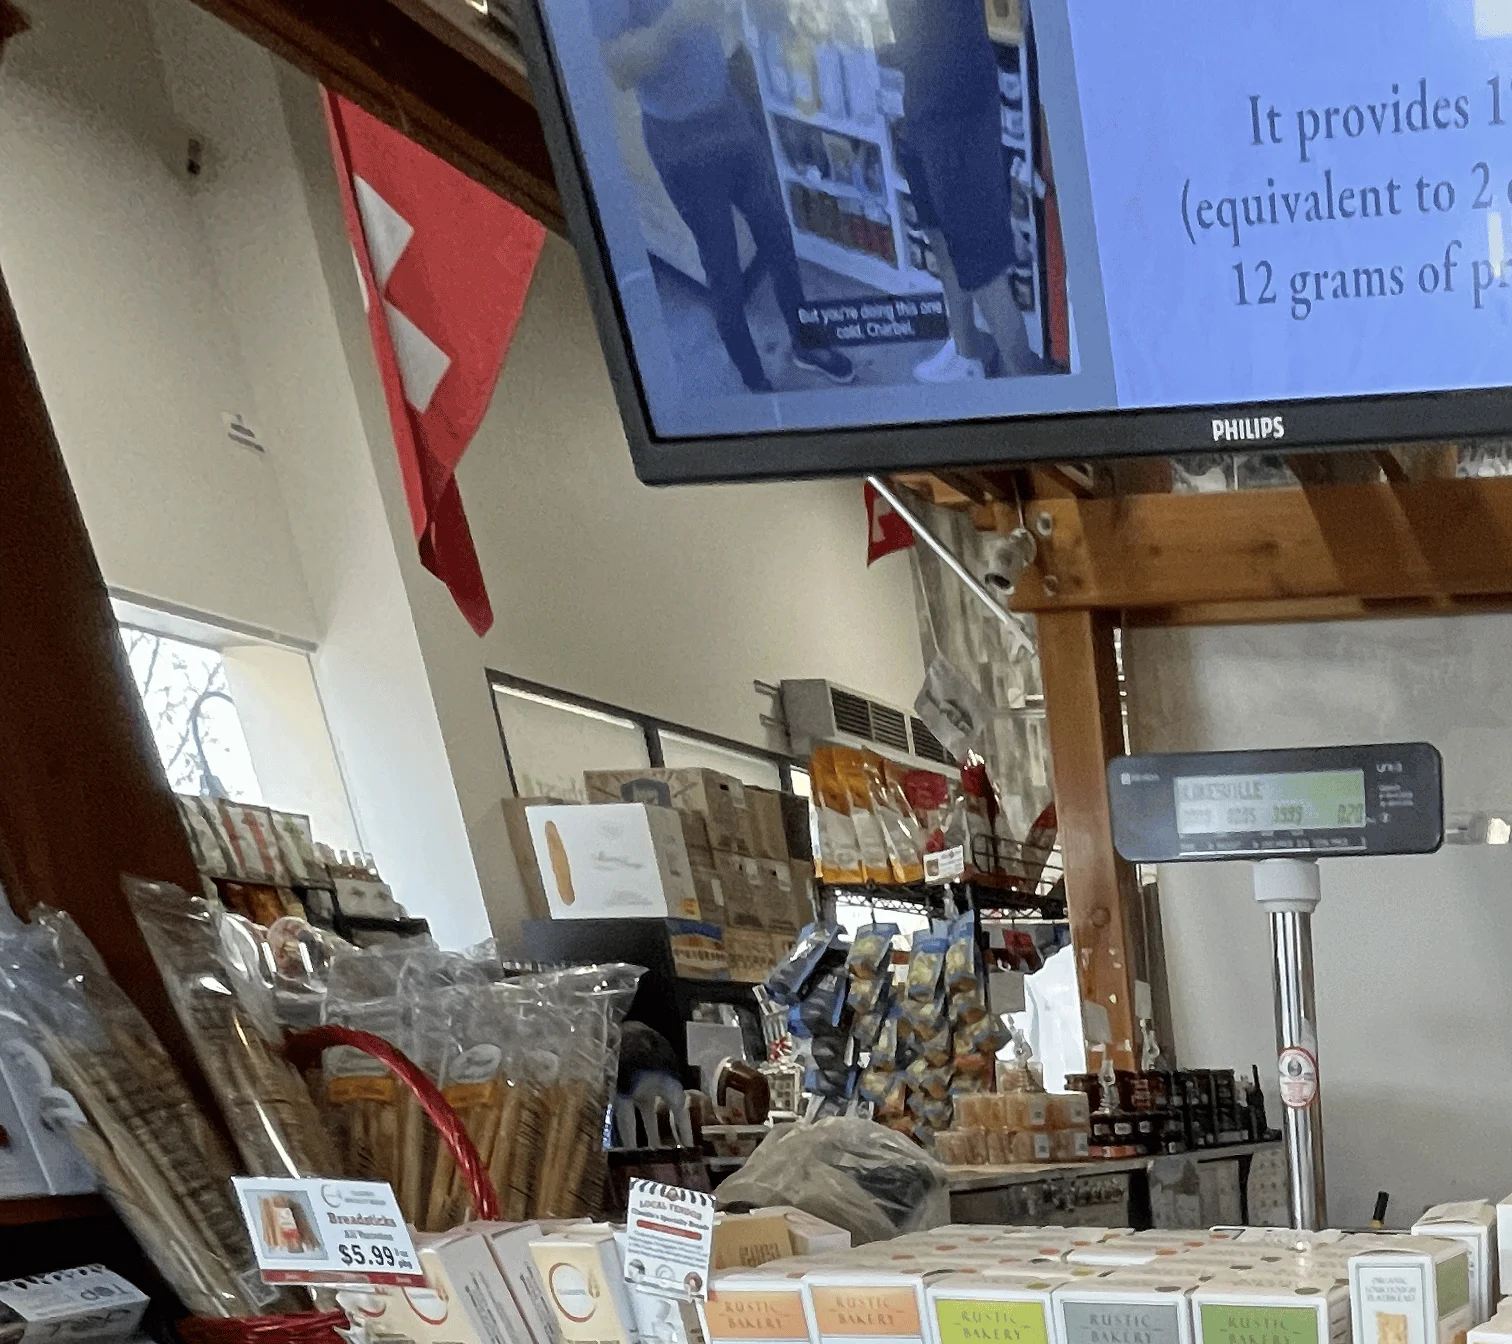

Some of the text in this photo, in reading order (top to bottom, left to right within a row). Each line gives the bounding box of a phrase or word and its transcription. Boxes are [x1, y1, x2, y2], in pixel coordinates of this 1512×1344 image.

[1250, 95, 1282, 147] It
[1298, 77, 1470, 162] provides
[1181, 168, 1403, 246] (equivalent
[1416, 175, 1456, 214] to
[1471, 162, 1494, 210] 2
[1232, 259, 1279, 306] 12
[1290, 264, 1404, 320] grams
[1418, 240, 1462, 293] of
[1212, 416, 1285, 441] PHILIPS
[339, 1244, 395, 1267] $5.99
